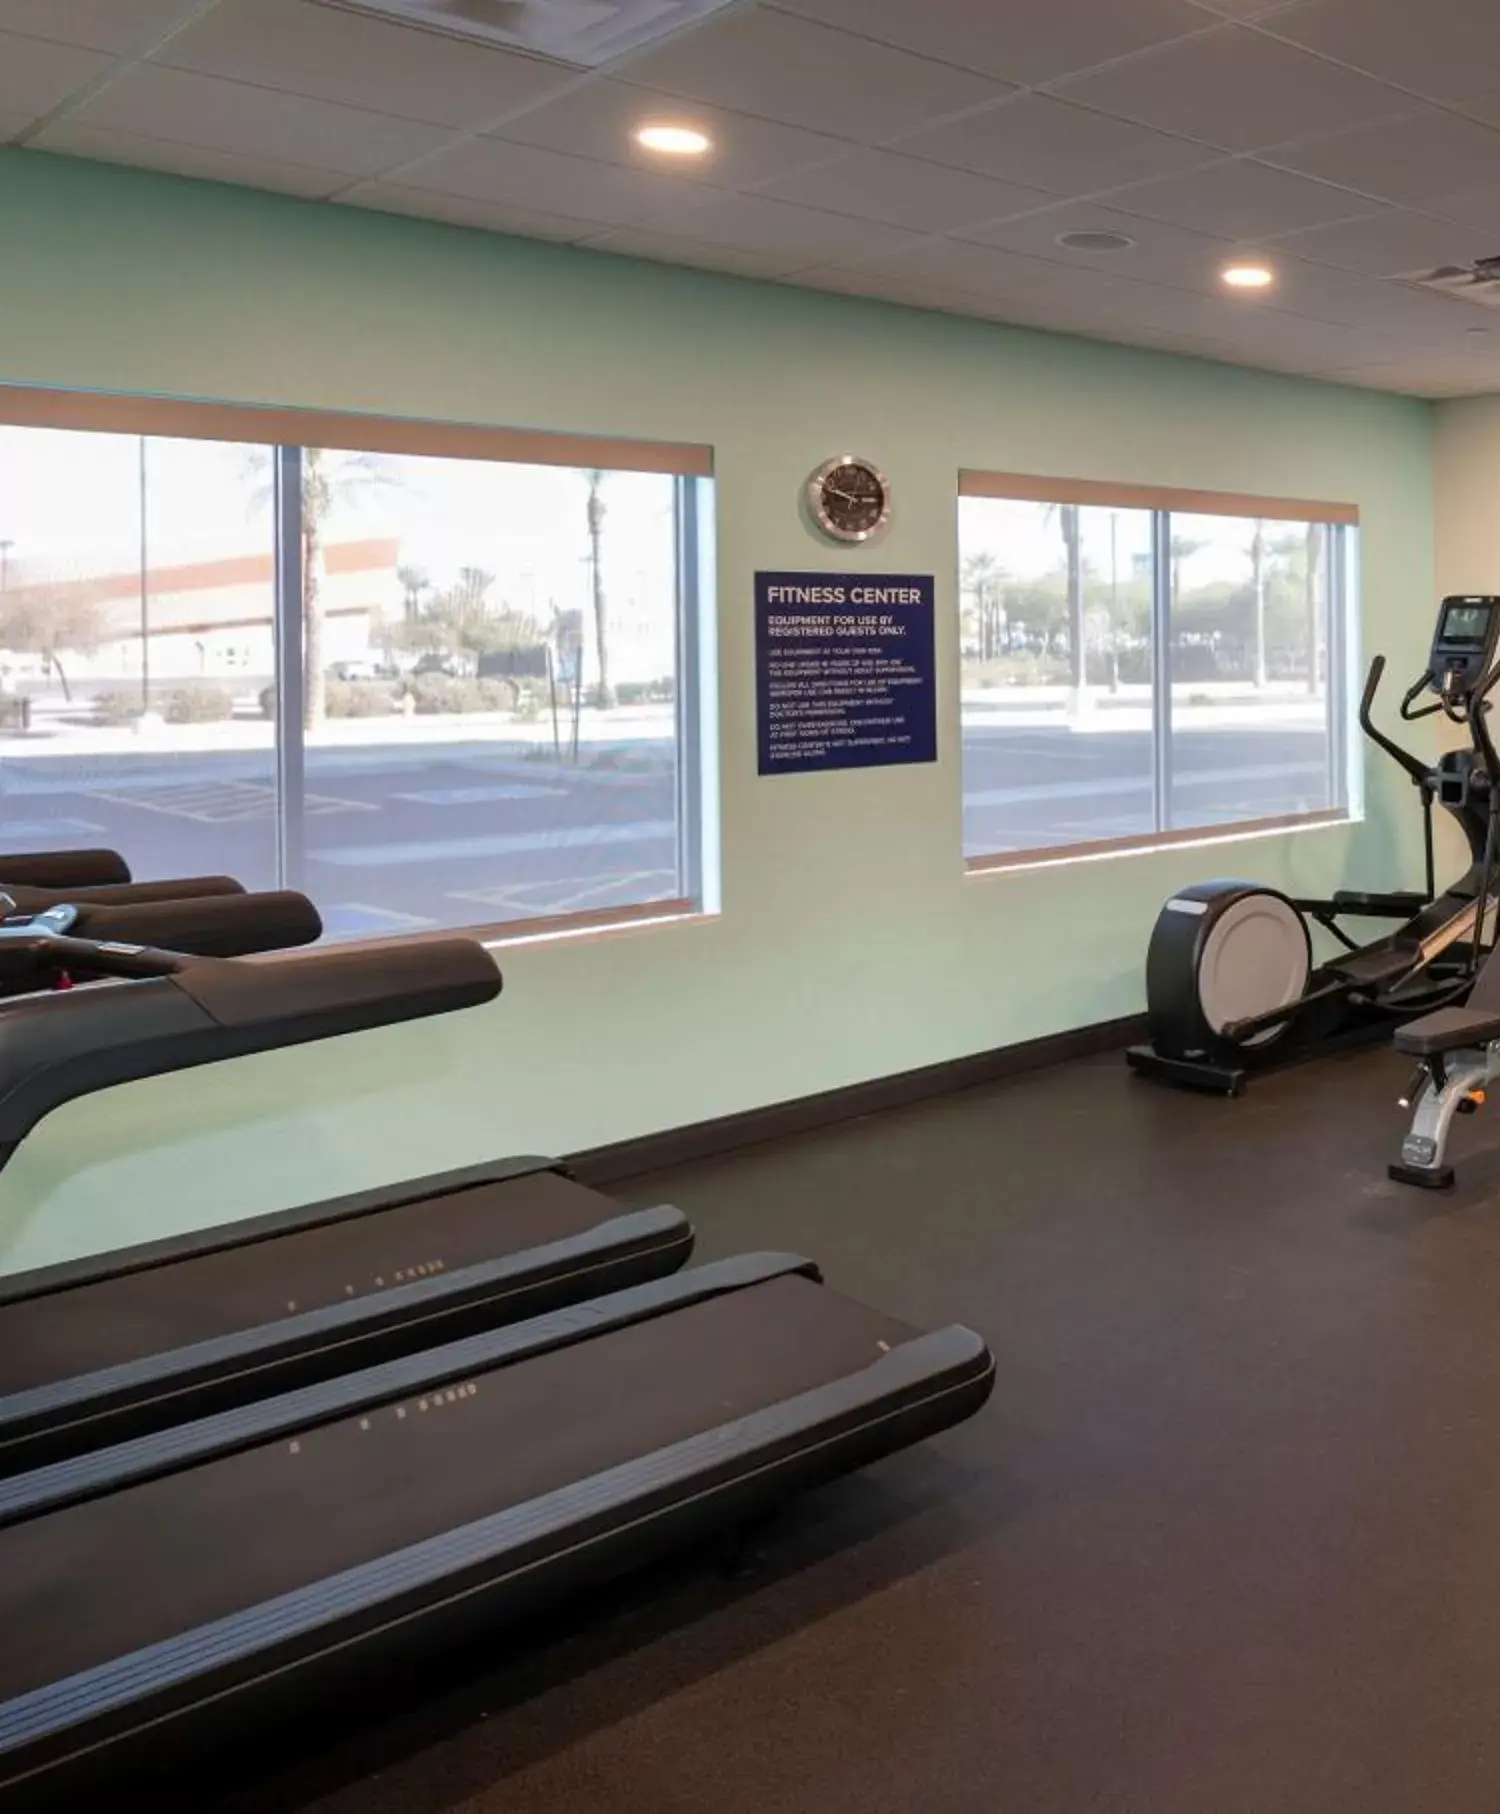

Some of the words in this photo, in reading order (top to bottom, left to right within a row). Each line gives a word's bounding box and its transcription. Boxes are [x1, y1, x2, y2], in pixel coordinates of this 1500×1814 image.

[767, 586, 846, 603] FITNESS
[850, 587, 921, 604] CENTER
[768, 615, 831, 626] EQUIPMENT
[833, 615, 855, 625] FOR
[857, 615, 878, 625] USE
[879, 616, 893, 625] BY
[768, 626, 834, 637] REGISTERED
[836, 626, 877, 636] GUESTS
[879, 626, 907, 635] ONLY.
